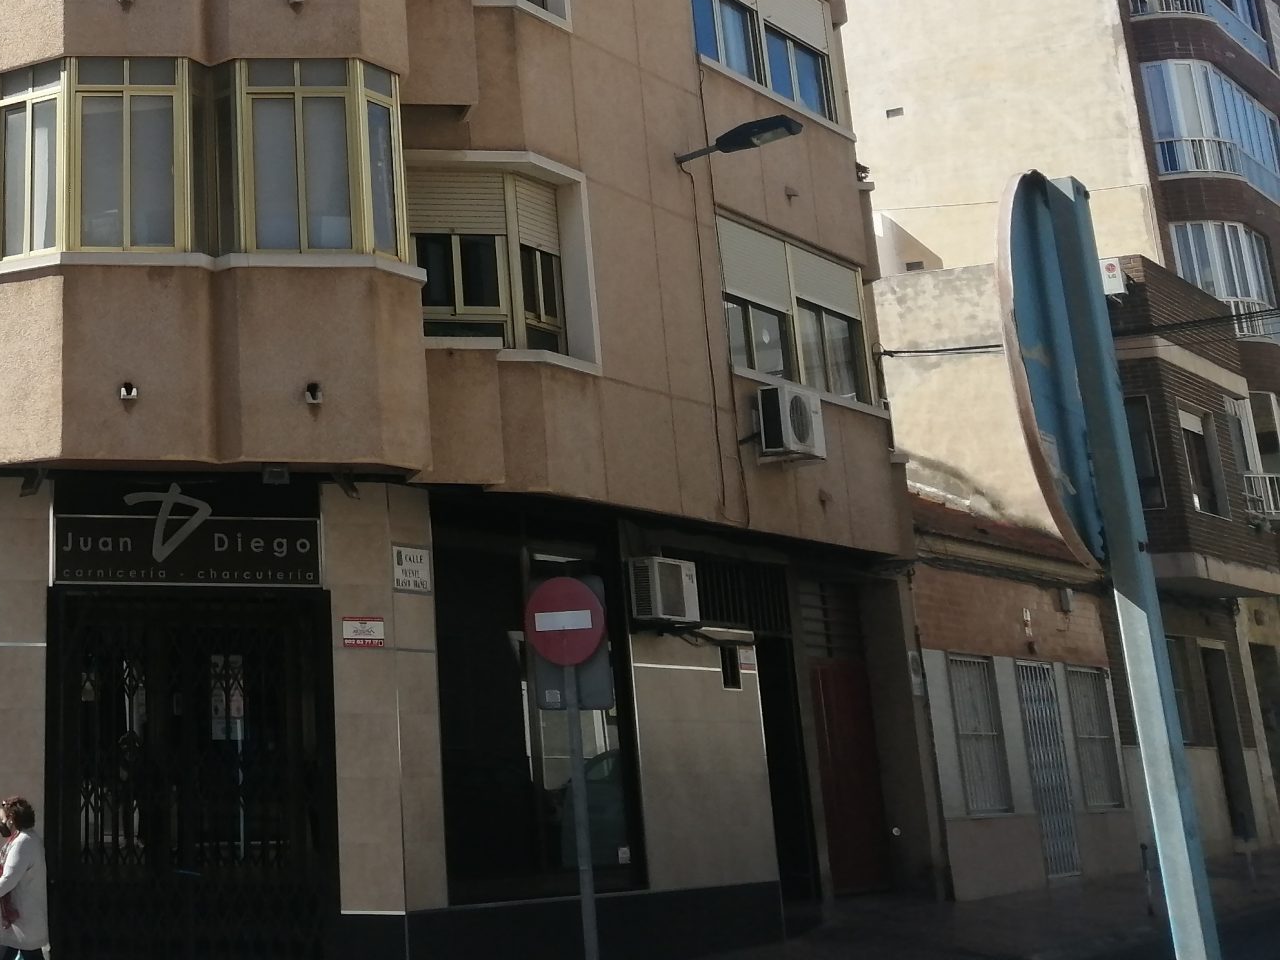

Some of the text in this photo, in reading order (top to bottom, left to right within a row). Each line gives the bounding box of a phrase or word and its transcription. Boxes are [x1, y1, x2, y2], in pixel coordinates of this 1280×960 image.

[62, 532, 132, 552] Juan
[214, 532, 311, 558] Diego
[63, 567, 166, 579] carnicería
[197, 568, 314, 581] charcutería
